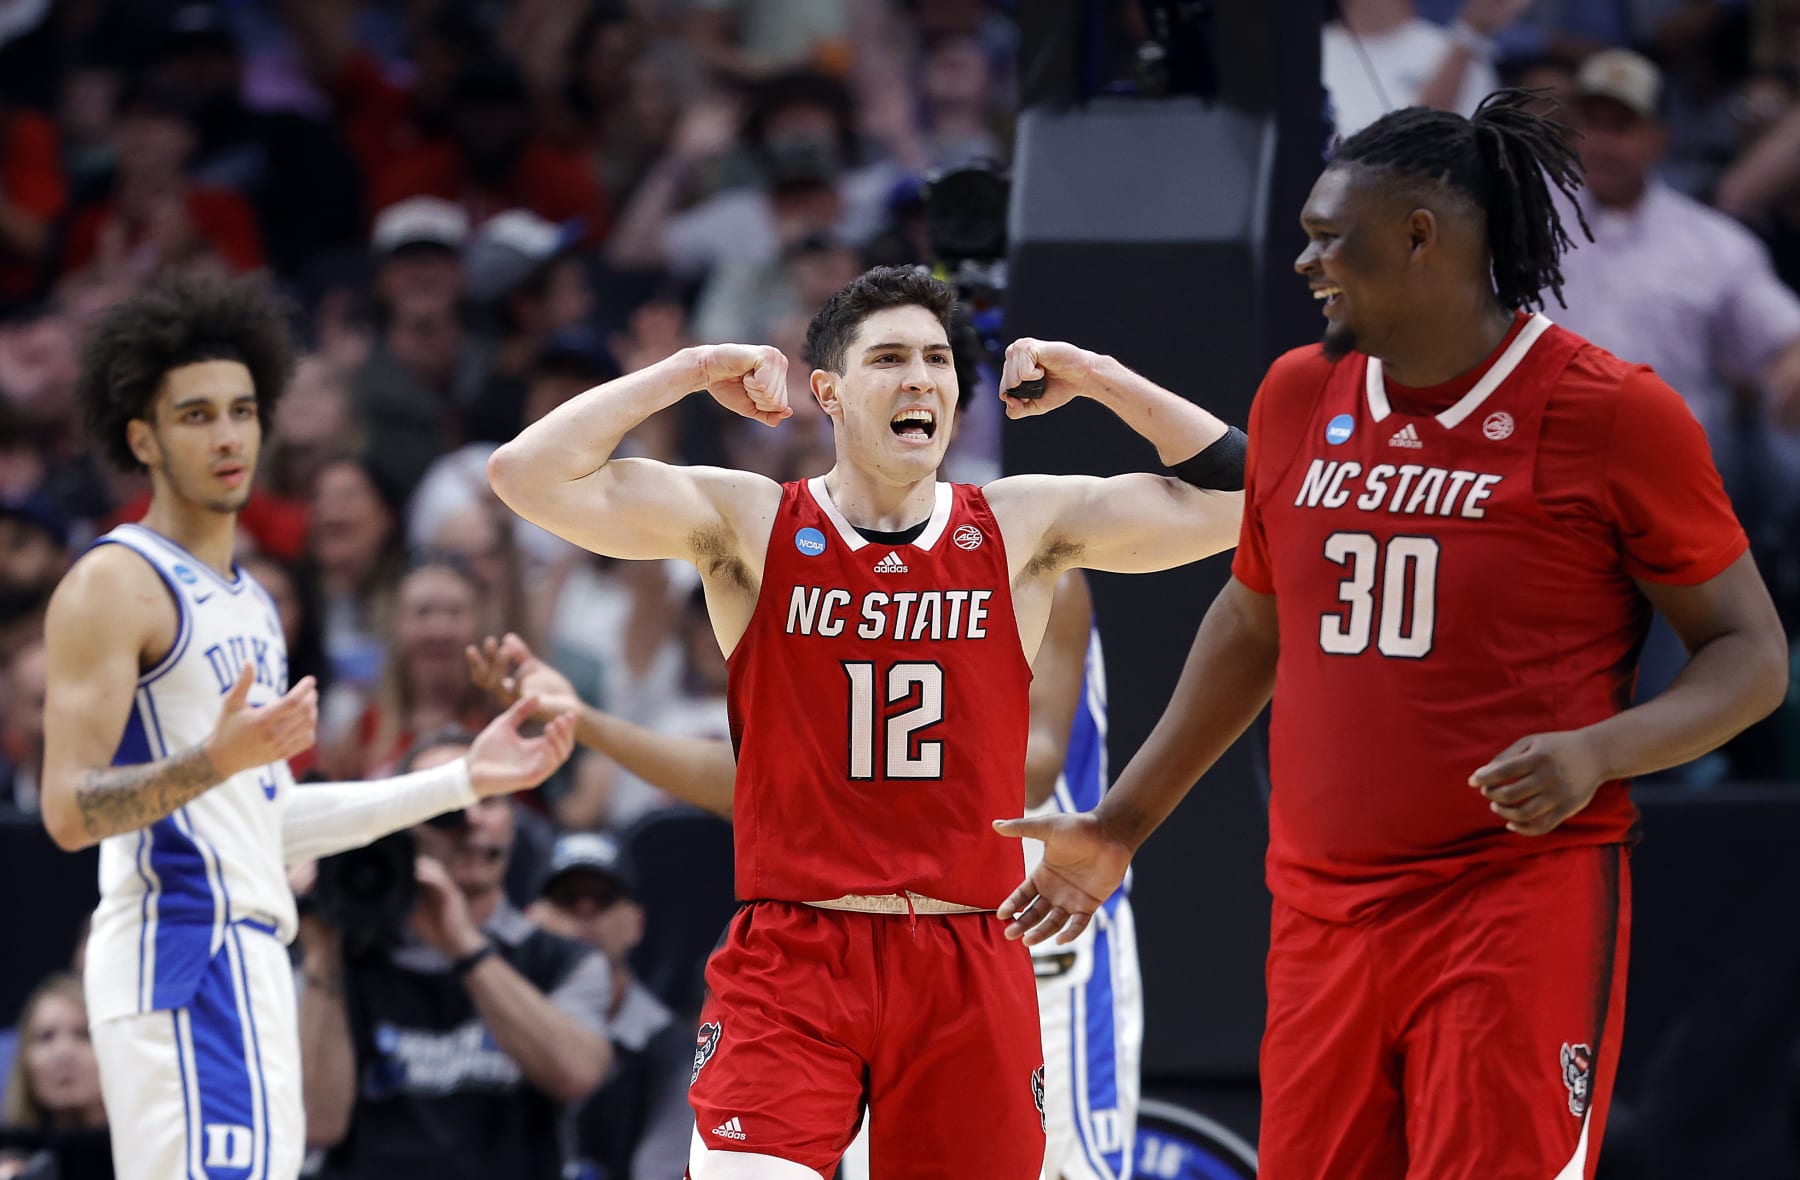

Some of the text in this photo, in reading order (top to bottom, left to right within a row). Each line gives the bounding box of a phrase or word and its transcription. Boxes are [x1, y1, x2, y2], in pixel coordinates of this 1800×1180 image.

[1294, 458, 1504, 519] NC STATE
[798, 538, 824, 551] NCAA
[873, 564, 909, 573] adidas
[785, 585, 993, 641] NC STATE
[1319, 531, 1441, 661] 30
[840, 660, 945, 780] 12
[204, 1124, 252, 1168] D
[711, 1127, 747, 1141] adidas
